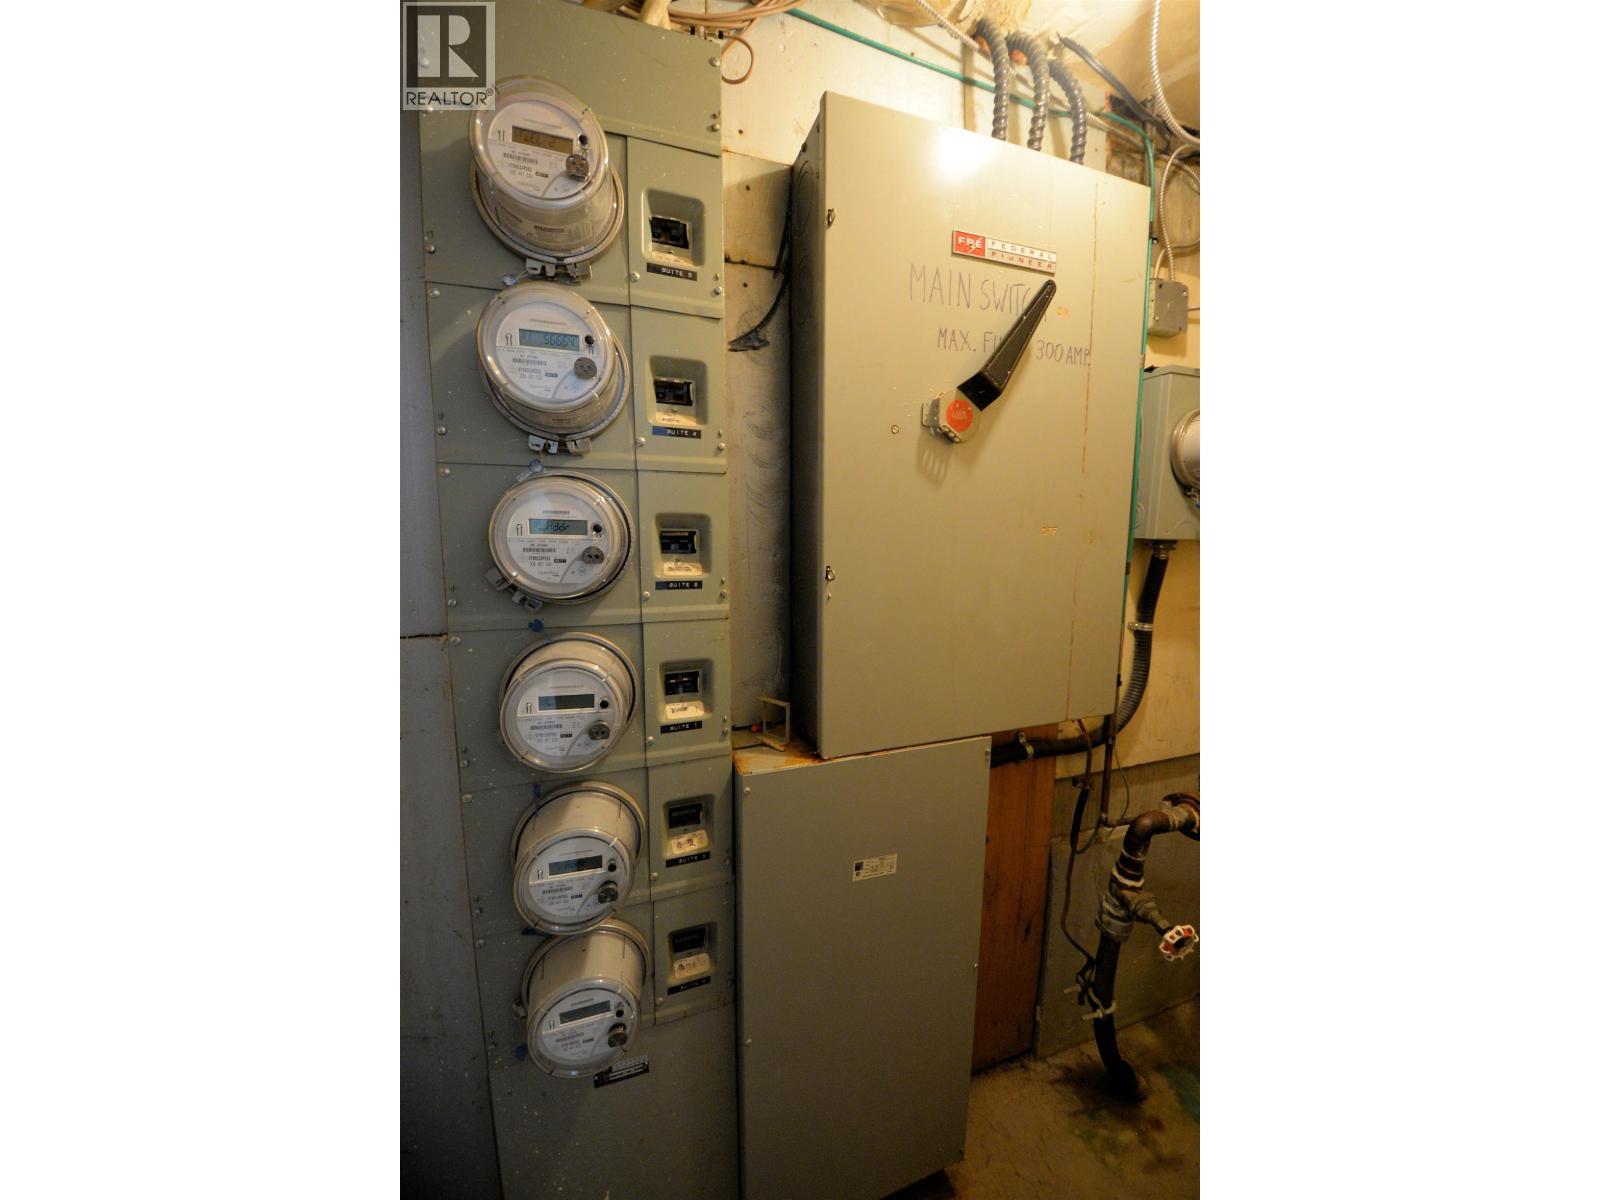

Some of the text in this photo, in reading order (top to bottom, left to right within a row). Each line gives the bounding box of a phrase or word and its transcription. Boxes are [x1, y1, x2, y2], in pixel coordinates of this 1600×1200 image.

[957, 235, 983, 250] FPE
[991, 240, 1054, 261] FEDERAL
[661, 267, 683, 276] SUITE
[909, 263, 1047, 323] MAIN SWITC
[937, 327, 977, 353] MAX.
[1035, 339, 1064, 363] 300
[668, 581, 690, 589] SUITE
